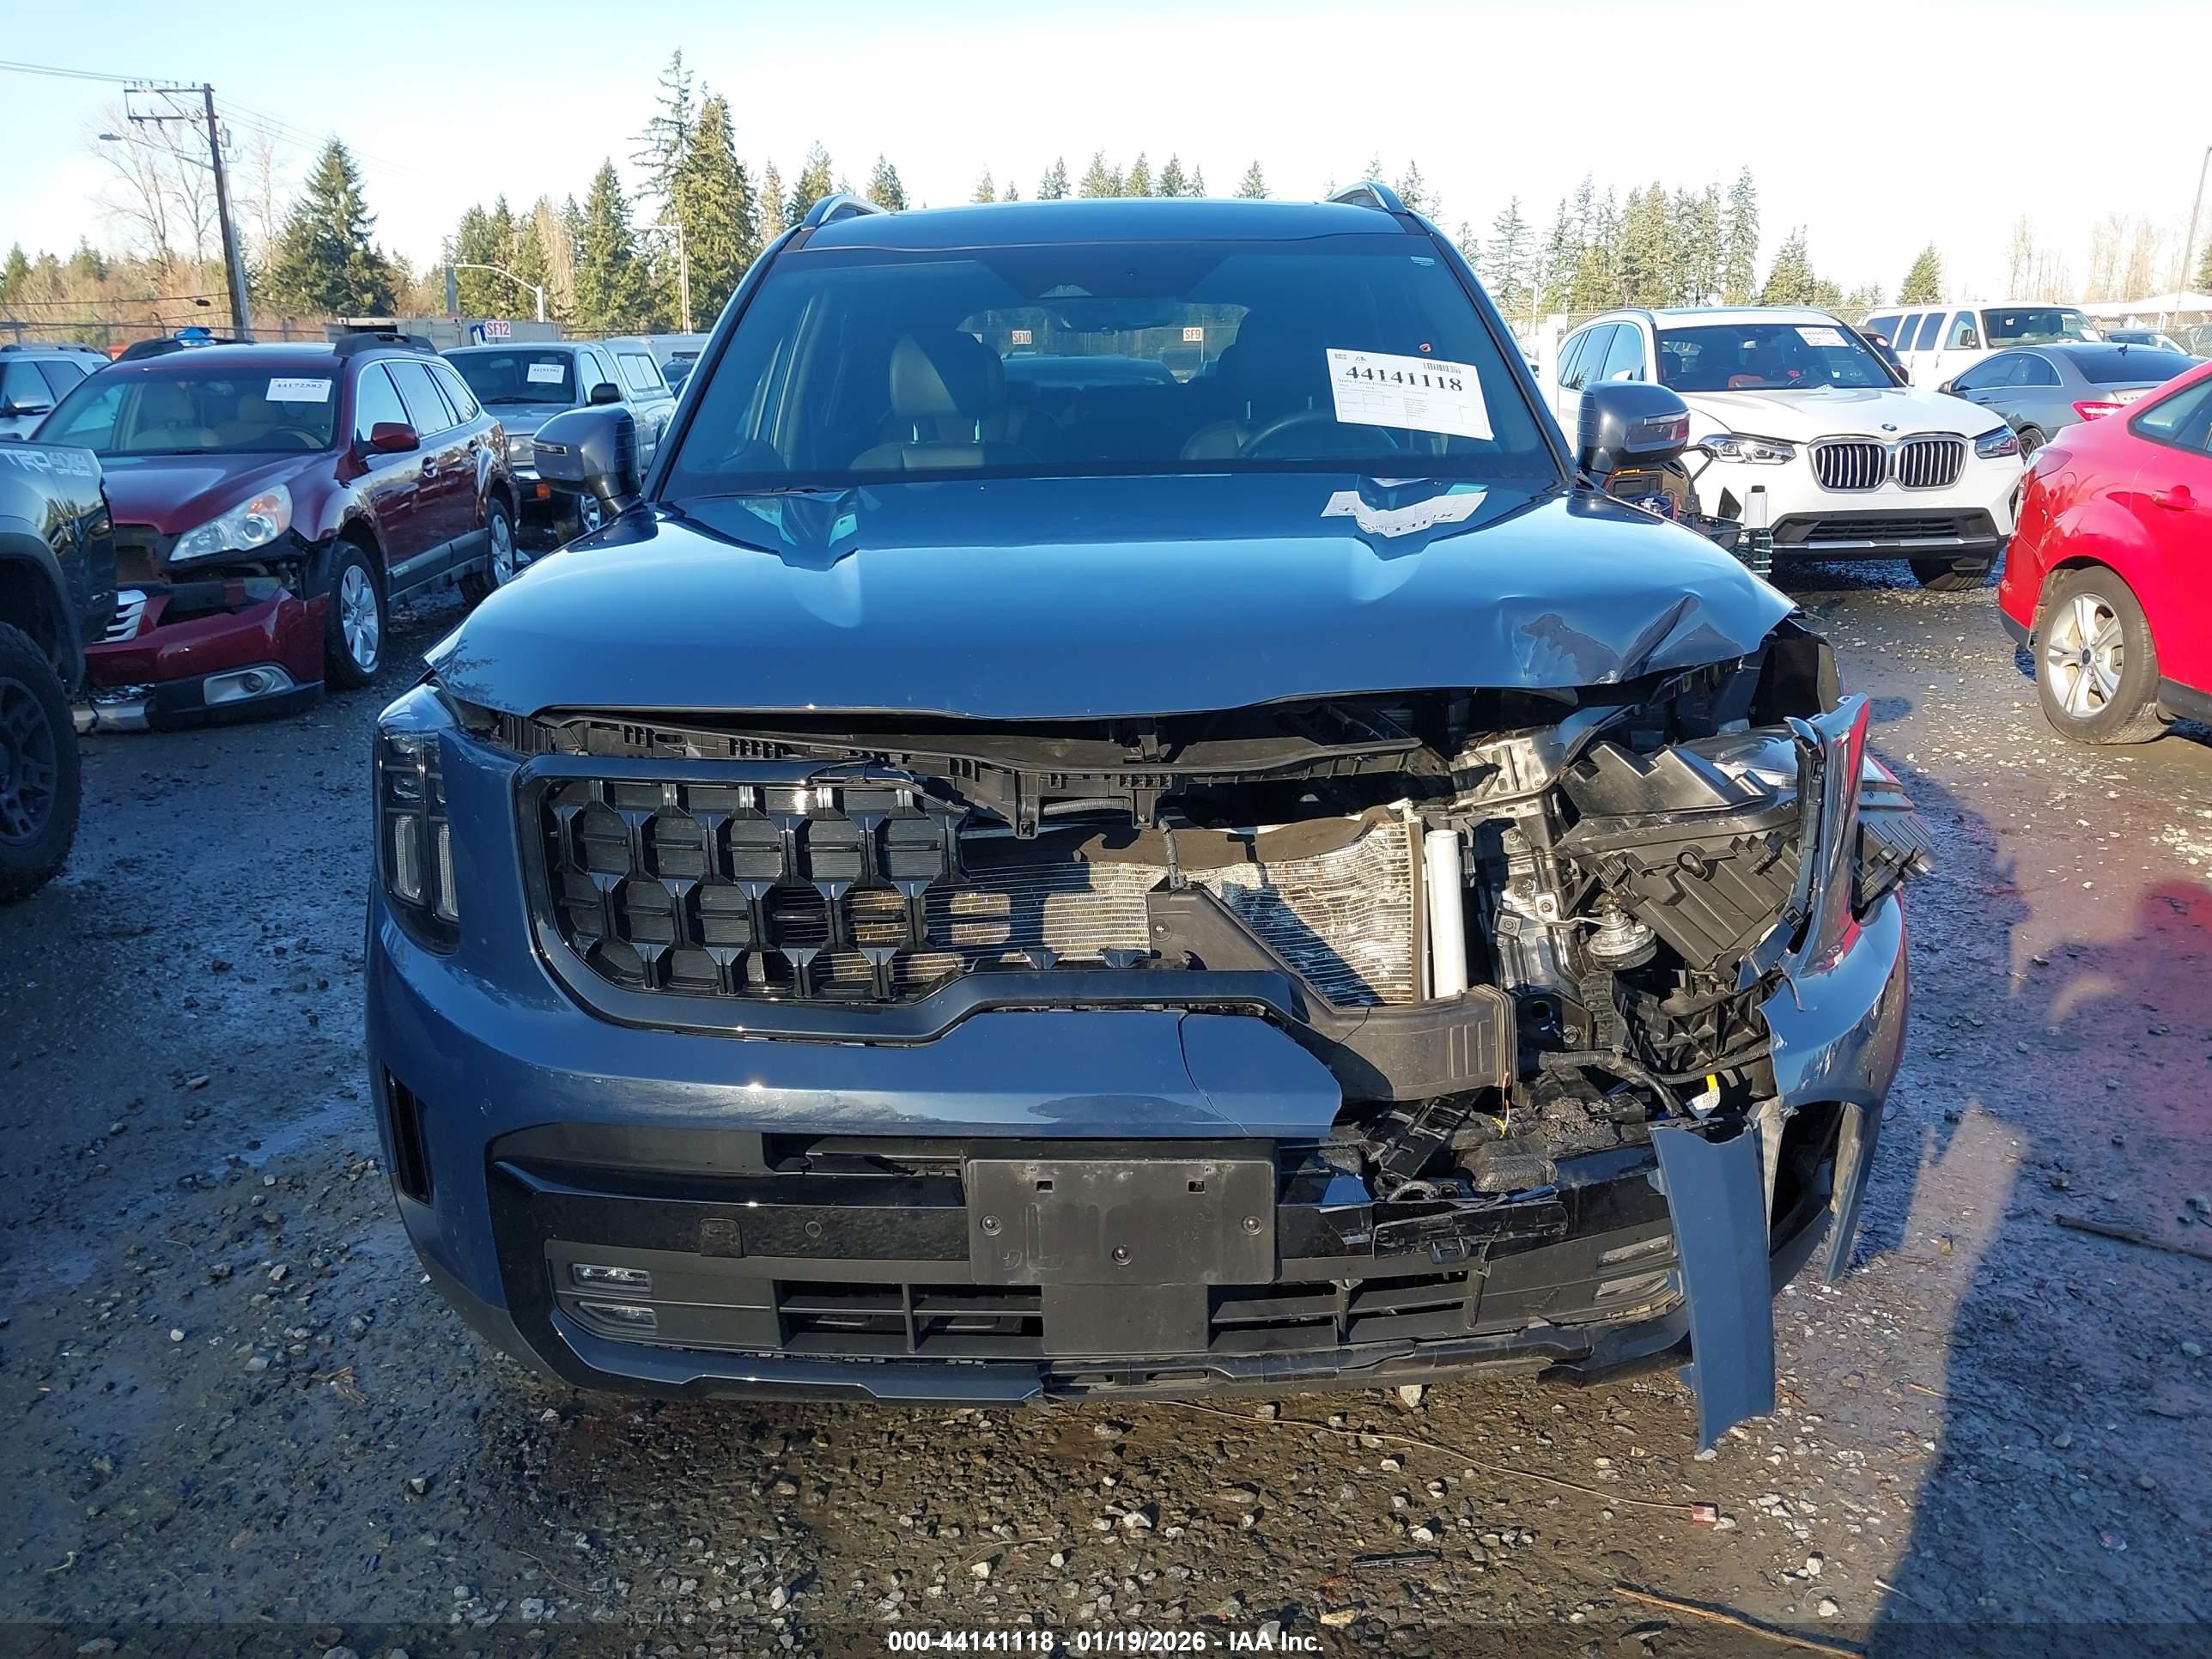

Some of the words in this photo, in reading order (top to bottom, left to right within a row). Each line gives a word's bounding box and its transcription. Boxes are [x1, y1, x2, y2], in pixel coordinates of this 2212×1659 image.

[486, 322, 510, 336] SF12
[1185, 329, 1201, 340] SF9
[1013, 331, 1031, 343] SF10
[1346, 366, 1463, 392] 44141118
